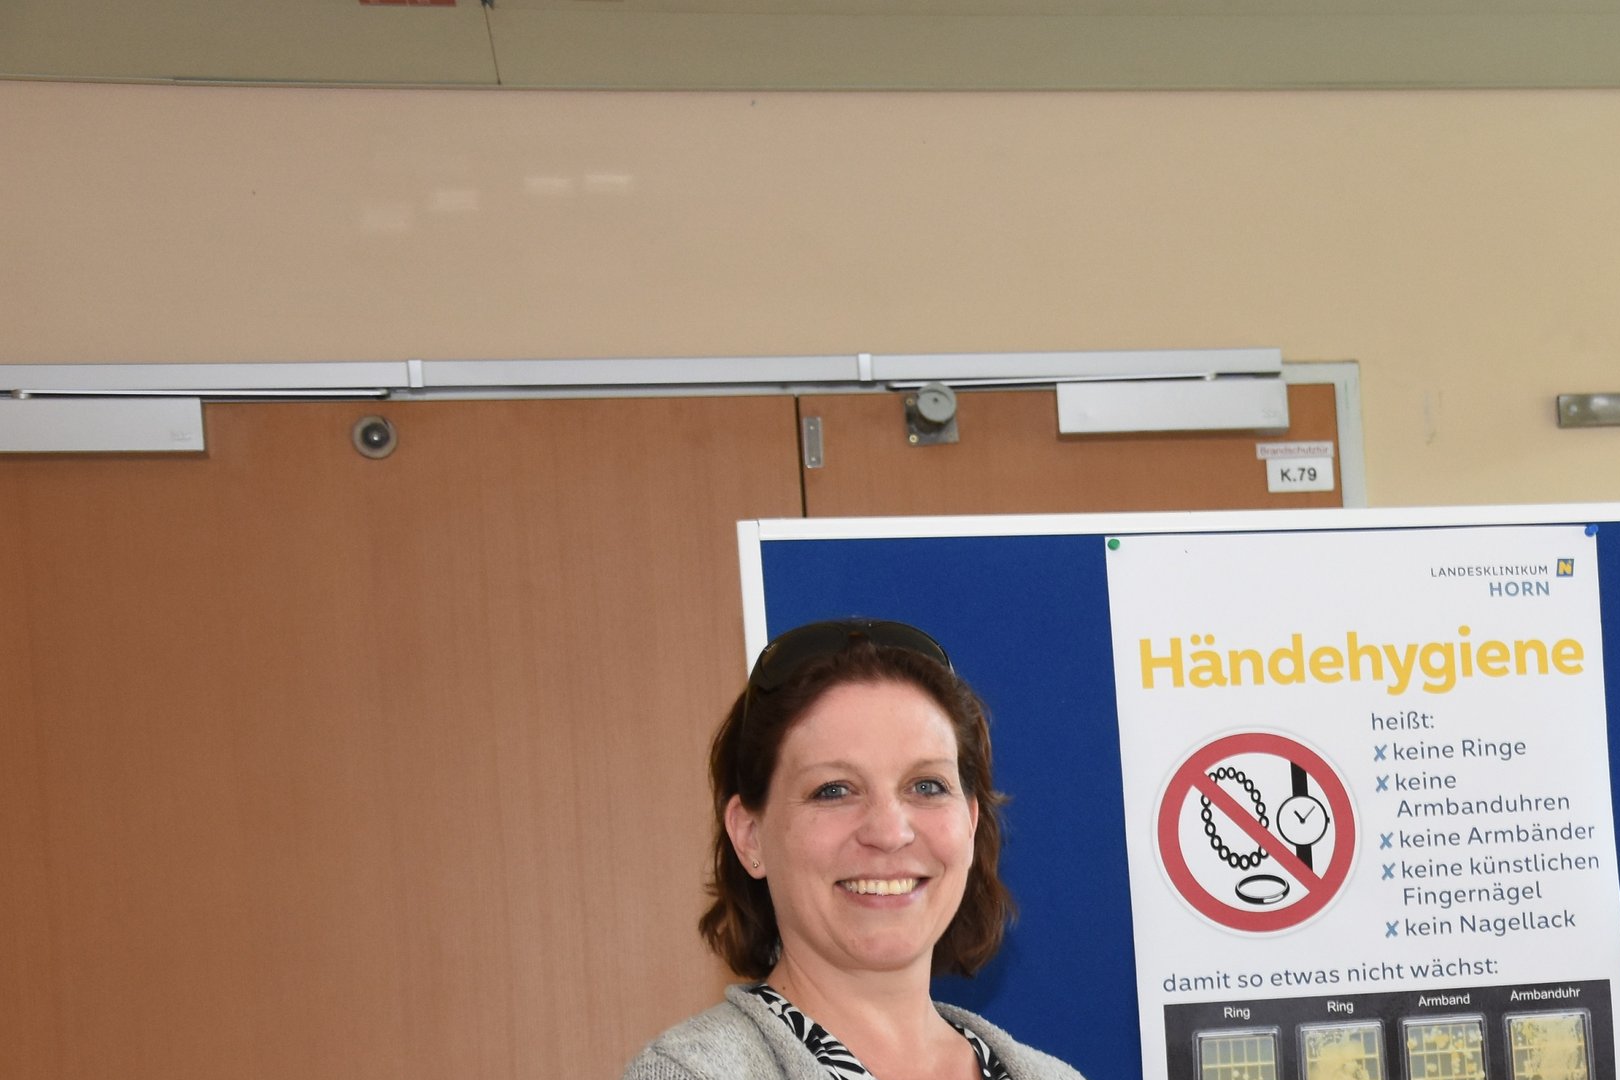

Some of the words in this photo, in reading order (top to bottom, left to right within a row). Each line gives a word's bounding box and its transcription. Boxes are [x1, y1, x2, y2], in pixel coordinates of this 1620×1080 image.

[1280, 467, 1317, 482] K.79
[1430, 565, 1548, 578] LANDESKLINIKUM
[1489, 581, 1550, 597] HORN
[1140, 626, 1585, 695] Händehygiene
[1371, 710, 1434, 731] heißt:
[1393, 741, 1454, 761] keine
[1461, 738, 1526, 761] Ringe
[1395, 771, 1457, 791] keine
[1397, 794, 1570, 818] Armbanduhren
[1399, 828, 1461, 848] keine
[1467, 822, 1596, 845] Armbänder
[1401, 858, 1463, 879] keine
[1469, 852, 1599, 875] künstlichen
[1403, 880, 1542, 909] Fingernägel
[1405, 916, 1452, 937] kein
[1460, 909, 1576, 937] Nagellack
[1163, 970, 1231, 993] damit
[1237, 973, 1263, 989] so
[1270, 969, 1340, 987] etwas
[1347, 962, 1404, 982] nicht
[1409, 957, 1498, 978] wächst:
[1418, 993, 1471, 1007] Armband
[1510, 987, 1581, 1002] Armbanduhr
[1223, 1006, 1251, 1020] Ring
[1327, 1001, 1354, 1014] Ring
